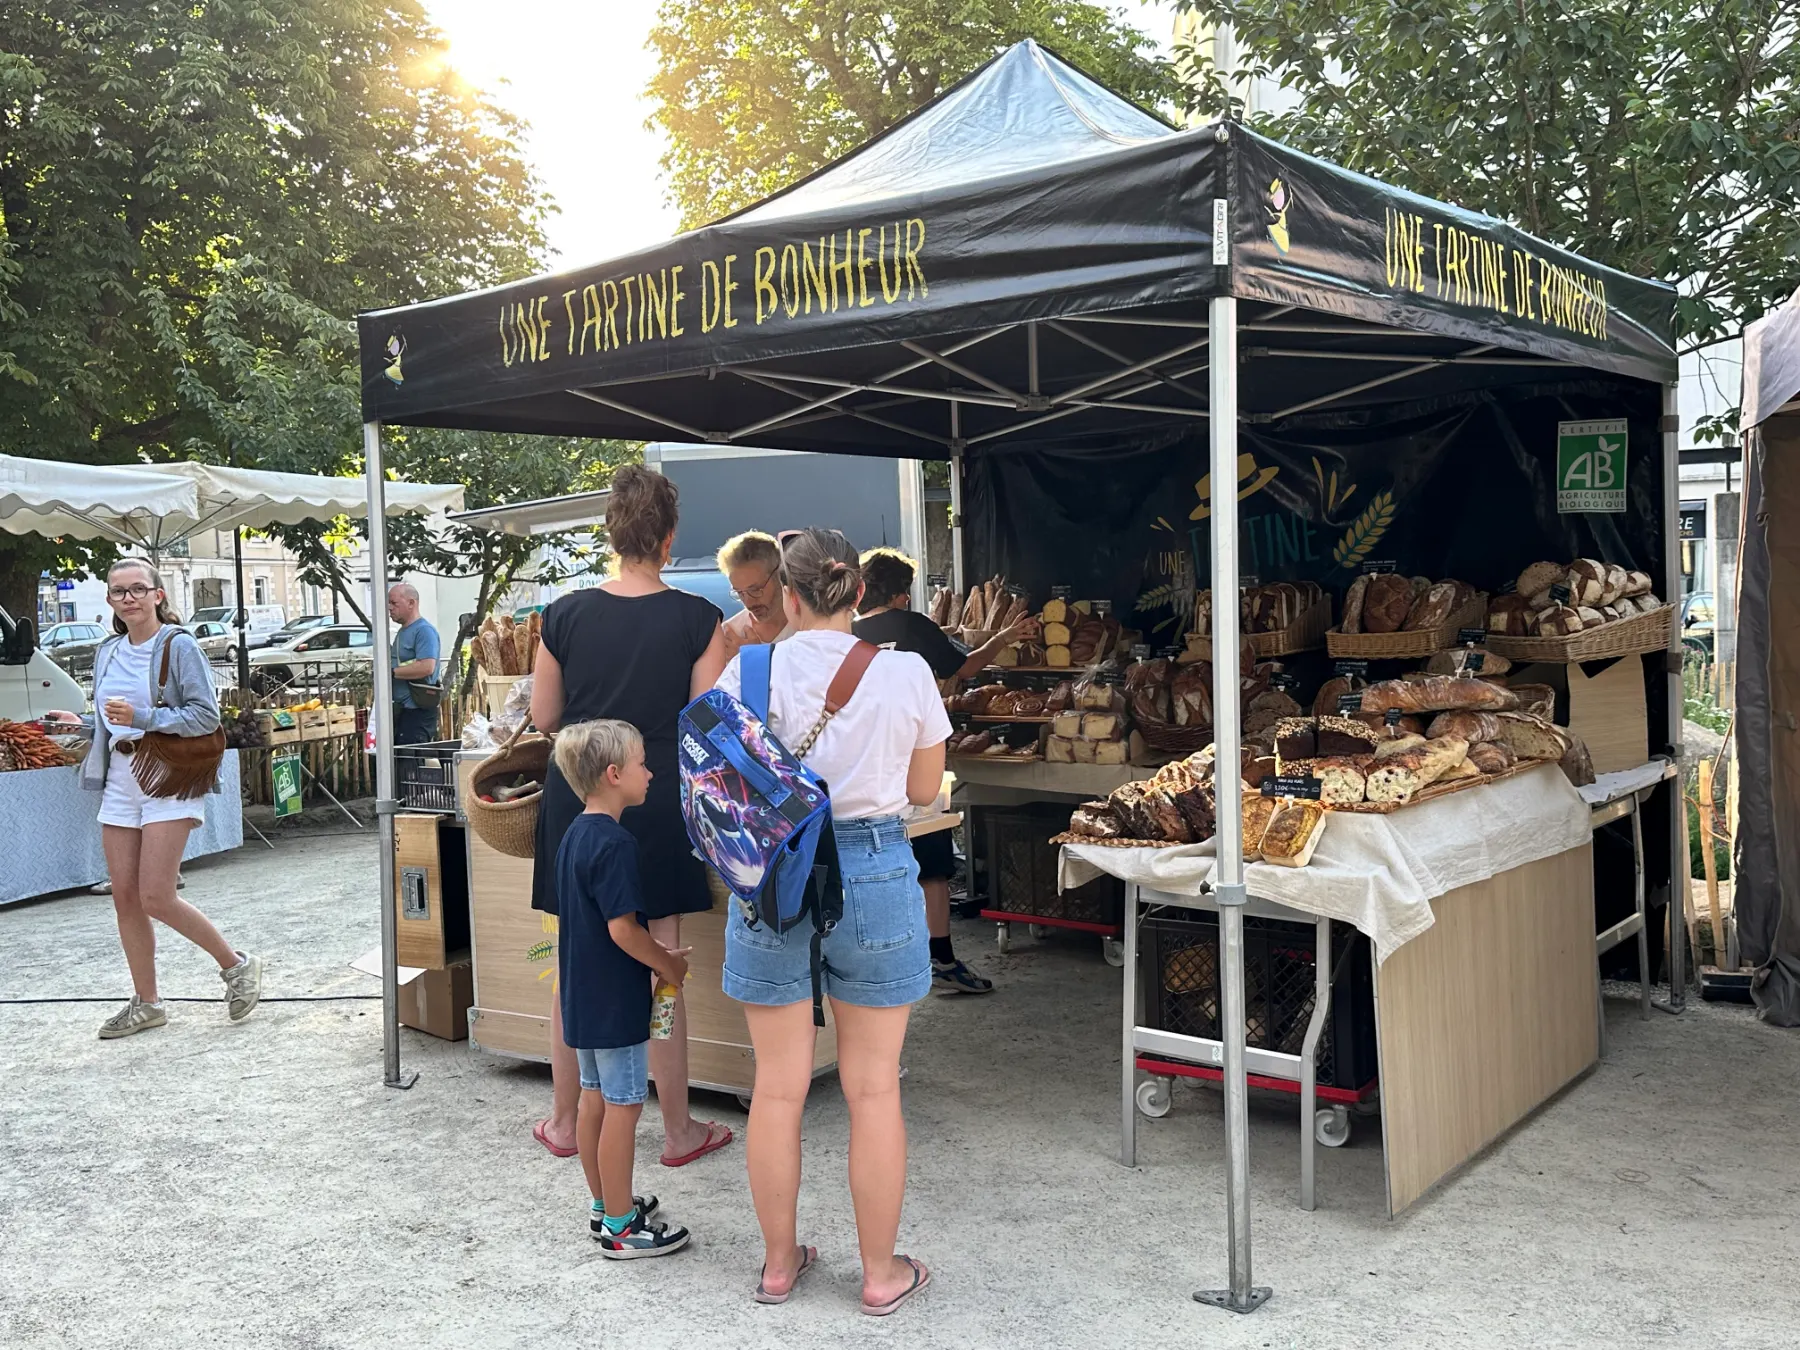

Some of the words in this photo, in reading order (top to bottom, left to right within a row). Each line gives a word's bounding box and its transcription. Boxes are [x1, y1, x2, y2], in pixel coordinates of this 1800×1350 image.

[1385, 207, 1425, 293] UNE
[1433, 223, 1508, 313] TARTINE
[1513, 250, 1535, 320] DE
[1540, 258, 1607, 341] BONHEUR
[500, 296, 552, 367] UNE
[562, 265, 686, 355] TARTINE
[702, 254, 739, 333] DE
[755, 218, 929, 325] BONHEUR
[1563, 450, 1615, 488] AB
[1559, 491, 1625, 500] AGRICULTURE
[1559, 500, 1625, 508] BIOLOGIQUE
[1159, 550, 1185, 575] UNE
[682, 741, 705, 765] LEAGUE
[683, 733, 710, 761] ROCKET
[278, 772, 291, 791] AB
